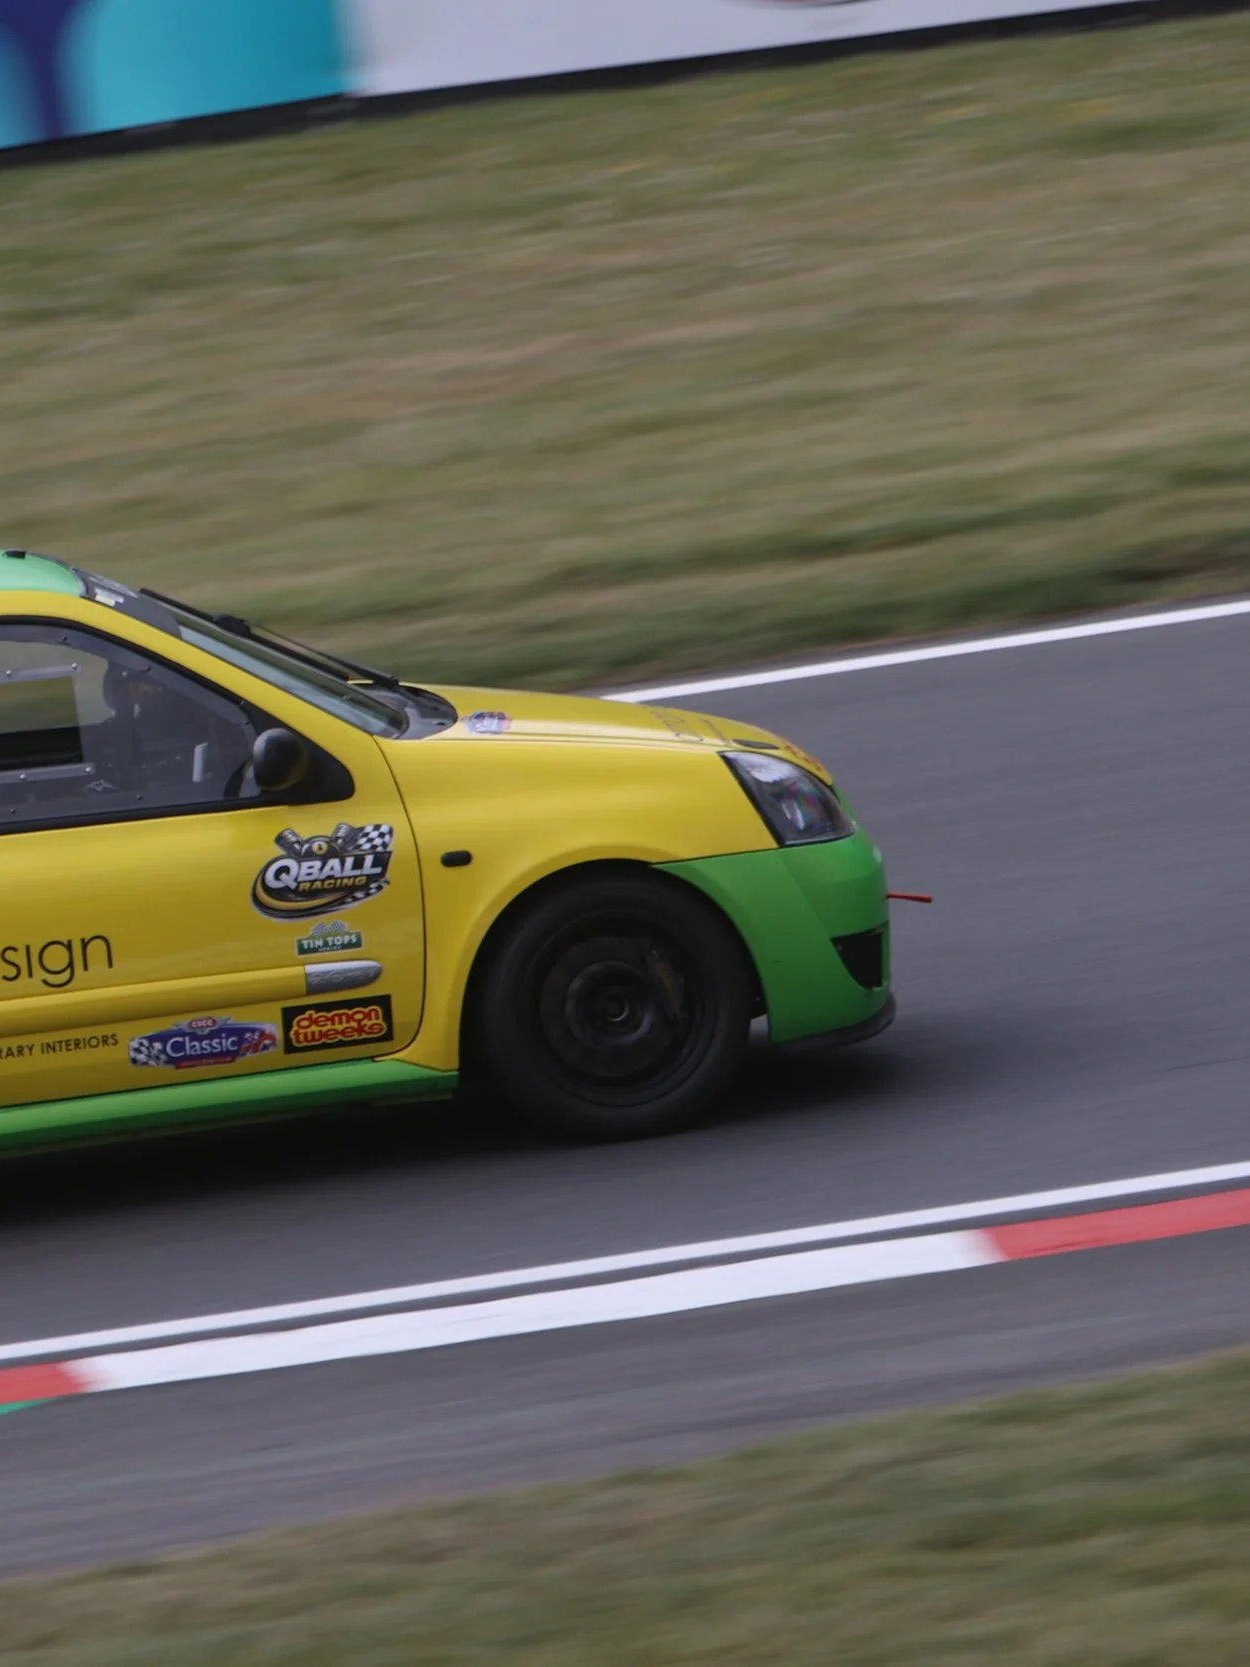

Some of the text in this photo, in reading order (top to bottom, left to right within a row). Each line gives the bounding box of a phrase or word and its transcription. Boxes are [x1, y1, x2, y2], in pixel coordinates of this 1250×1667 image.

[265, 855, 382, 890] QBALL
[298, 876, 367, 892] RACING
[301, 938, 323, 949] TIN
[327, 934, 357, 946] TOPS
[296, 1007, 381, 1030] demon
[41, 1033, 119, 1055] INTERIORS
[292, 1021, 385, 1045] tweeks
[166, 1034, 238, 1057] Classic
